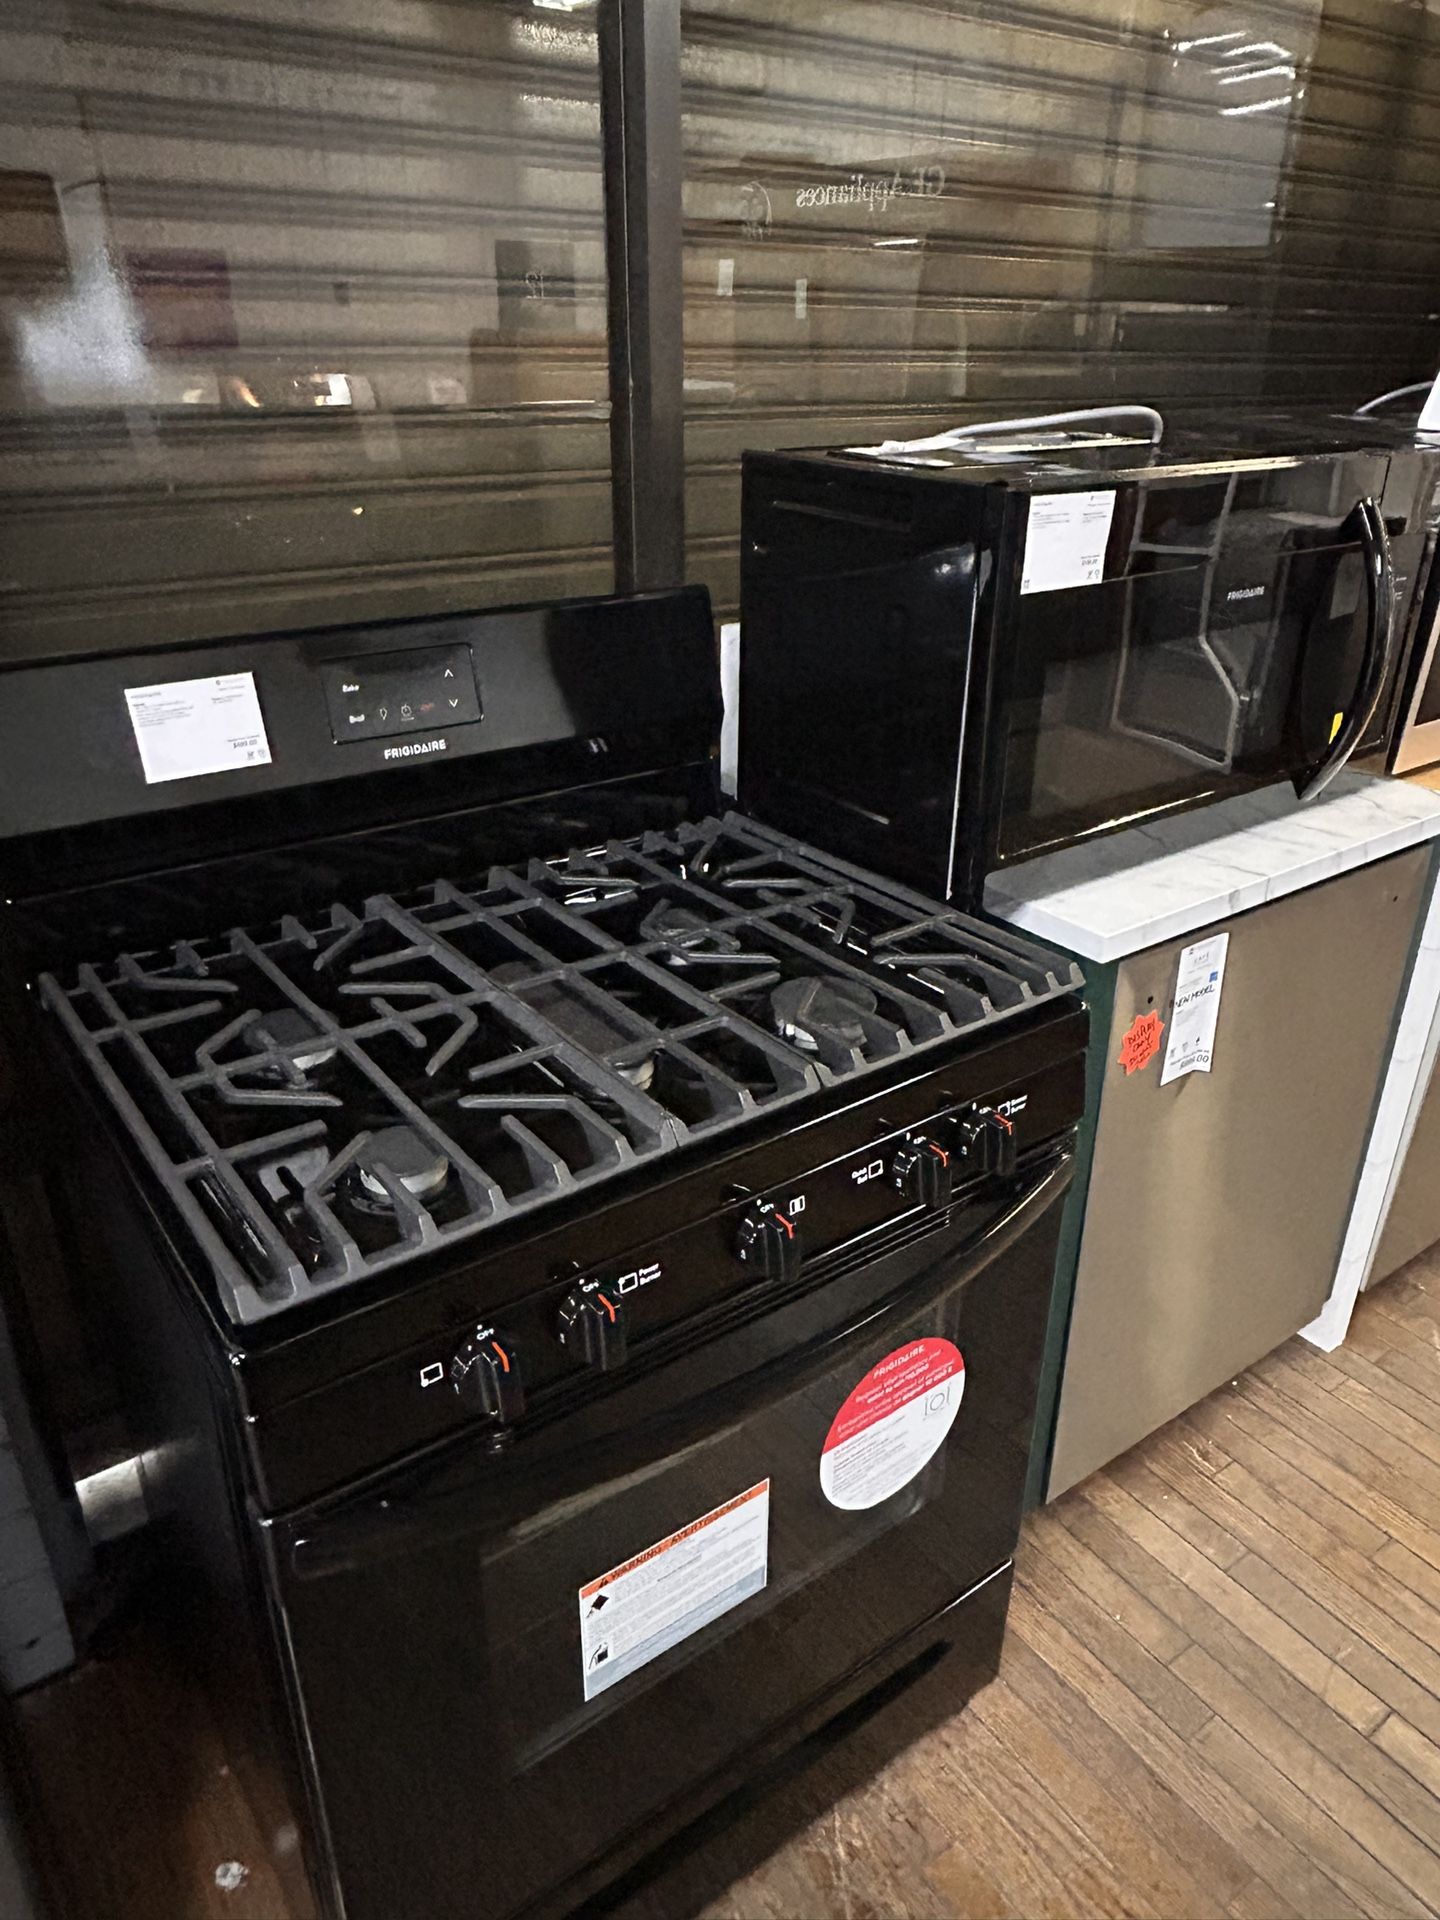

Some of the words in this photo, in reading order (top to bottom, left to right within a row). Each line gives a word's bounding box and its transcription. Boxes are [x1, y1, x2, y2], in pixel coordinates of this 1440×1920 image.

[1227, 586, 1265, 601] FRIGIDAIRE
[383, 738, 446, 760] FRIGIDAIRE
[873, 1344, 926, 1380] FRIGIDAIRE
[611, 1547, 663, 1581] WARNING
